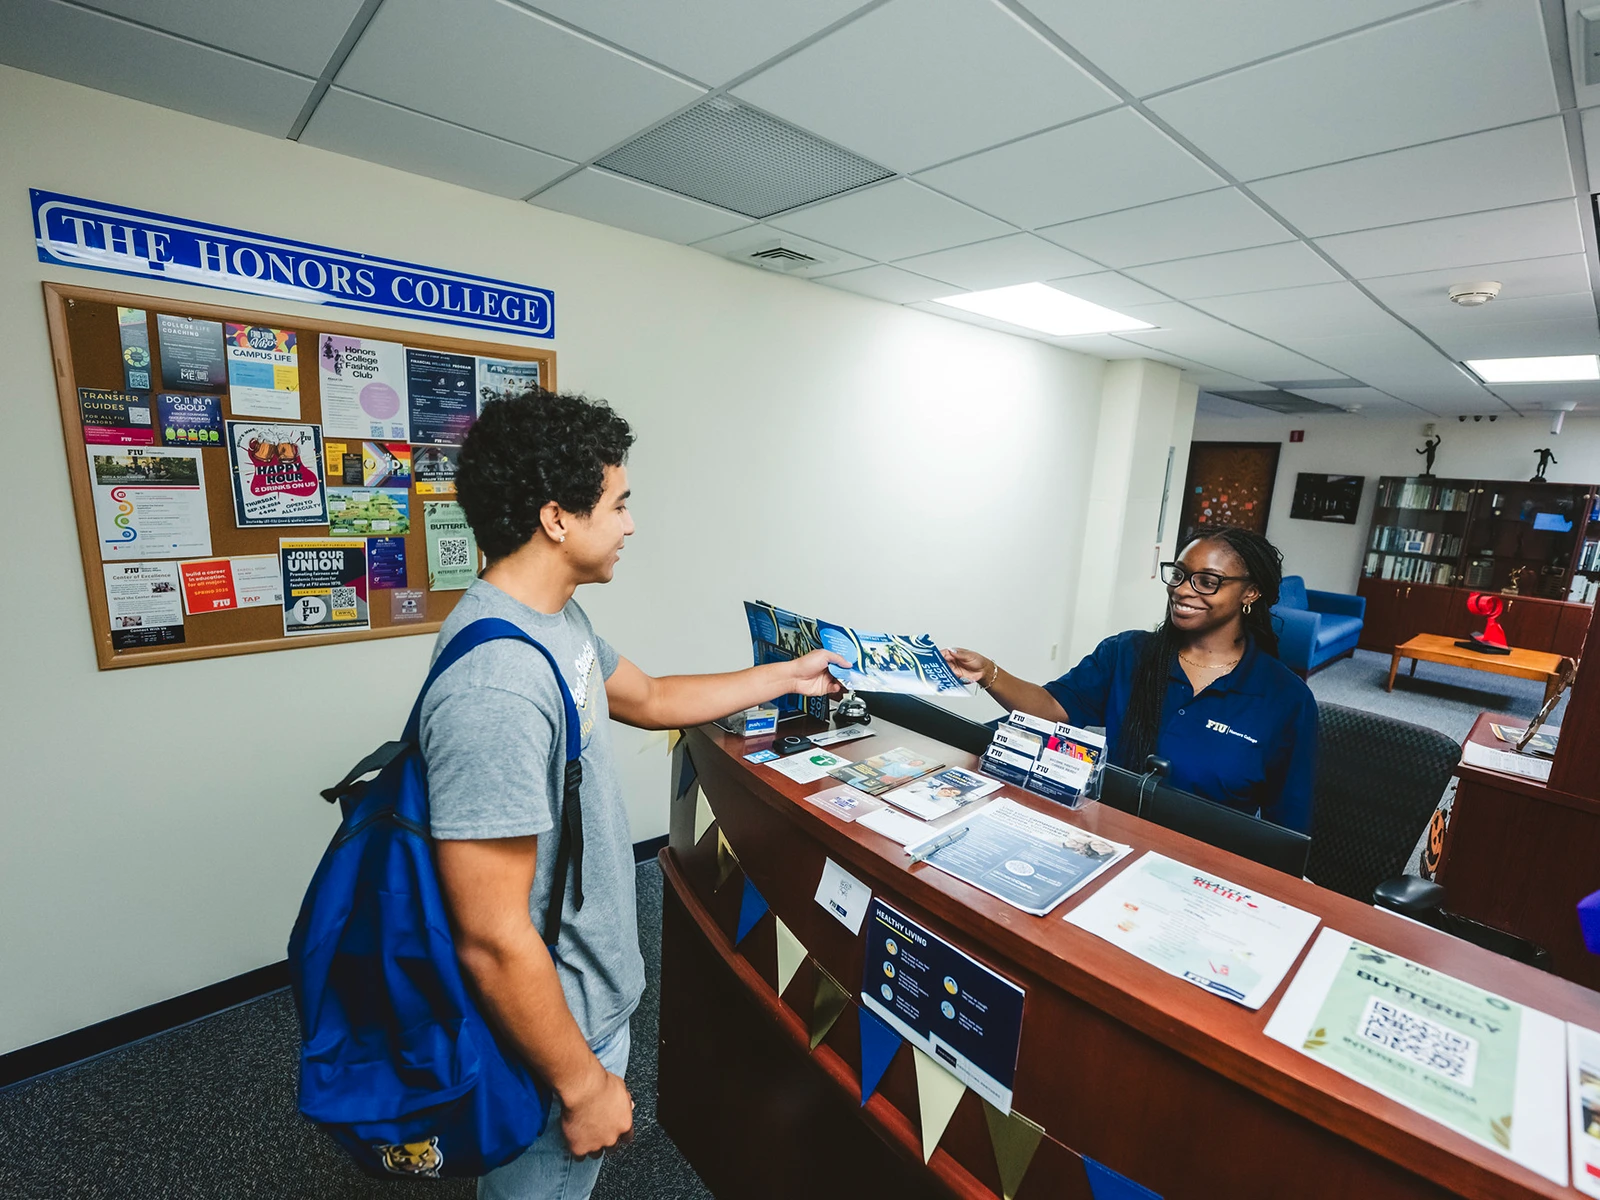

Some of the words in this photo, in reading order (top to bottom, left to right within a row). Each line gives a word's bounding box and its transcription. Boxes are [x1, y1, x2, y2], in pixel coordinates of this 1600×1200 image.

[61, 215, 174, 264] THE
[195, 238, 376, 298] HONORS
[391, 276, 540, 324] COLLEGE
[162, 321, 193, 330] COLLEGE
[163, 328, 199, 337] COACHING
[233, 349, 272, 360] CAMPUS
[345, 346, 376, 356] Honors
[346, 354, 378, 364] College
[346, 362, 379, 372] Fashion
[353, 370, 372, 379] Club
[82, 392, 139, 402] TRANSFER
[84, 402, 125, 410] GUIDES
[255, 463, 301, 475] HAPPY
[266, 473, 303, 485] HOUR
[261, 482, 291, 492] DRINKS
[245, 496, 277, 507] THURSDAY
[293, 503, 321, 512] FACULTY
[287, 551, 317, 560] JOIN
[319, 550, 344, 559] OUR
[288, 558, 344, 572] UNION
[213, 598, 230, 608] FIU
[1013, 714, 1025, 722] FIU
[1058, 726, 1071, 734] FIU
[1205, 719, 1228, 733] FIU
[1229, 729, 1244, 738] Honors
[1244, 734, 1258, 743] College
[996, 735, 1008, 743] FIU
[991, 749, 1003, 757] FIU
[1036, 764, 1049, 774] FIU
[1193, 879, 1243, 902] RELIEF
[876, 908, 904, 932] HEALTHY
[904, 927, 927, 947] LIVING
[1406, 963, 1430, 976] FIU
[1356, 970, 1501, 1033] BUTTERFLY
[1343, 1036, 1416, 1074] INTEREST
[1424, 1075, 1477, 1104] FORM
